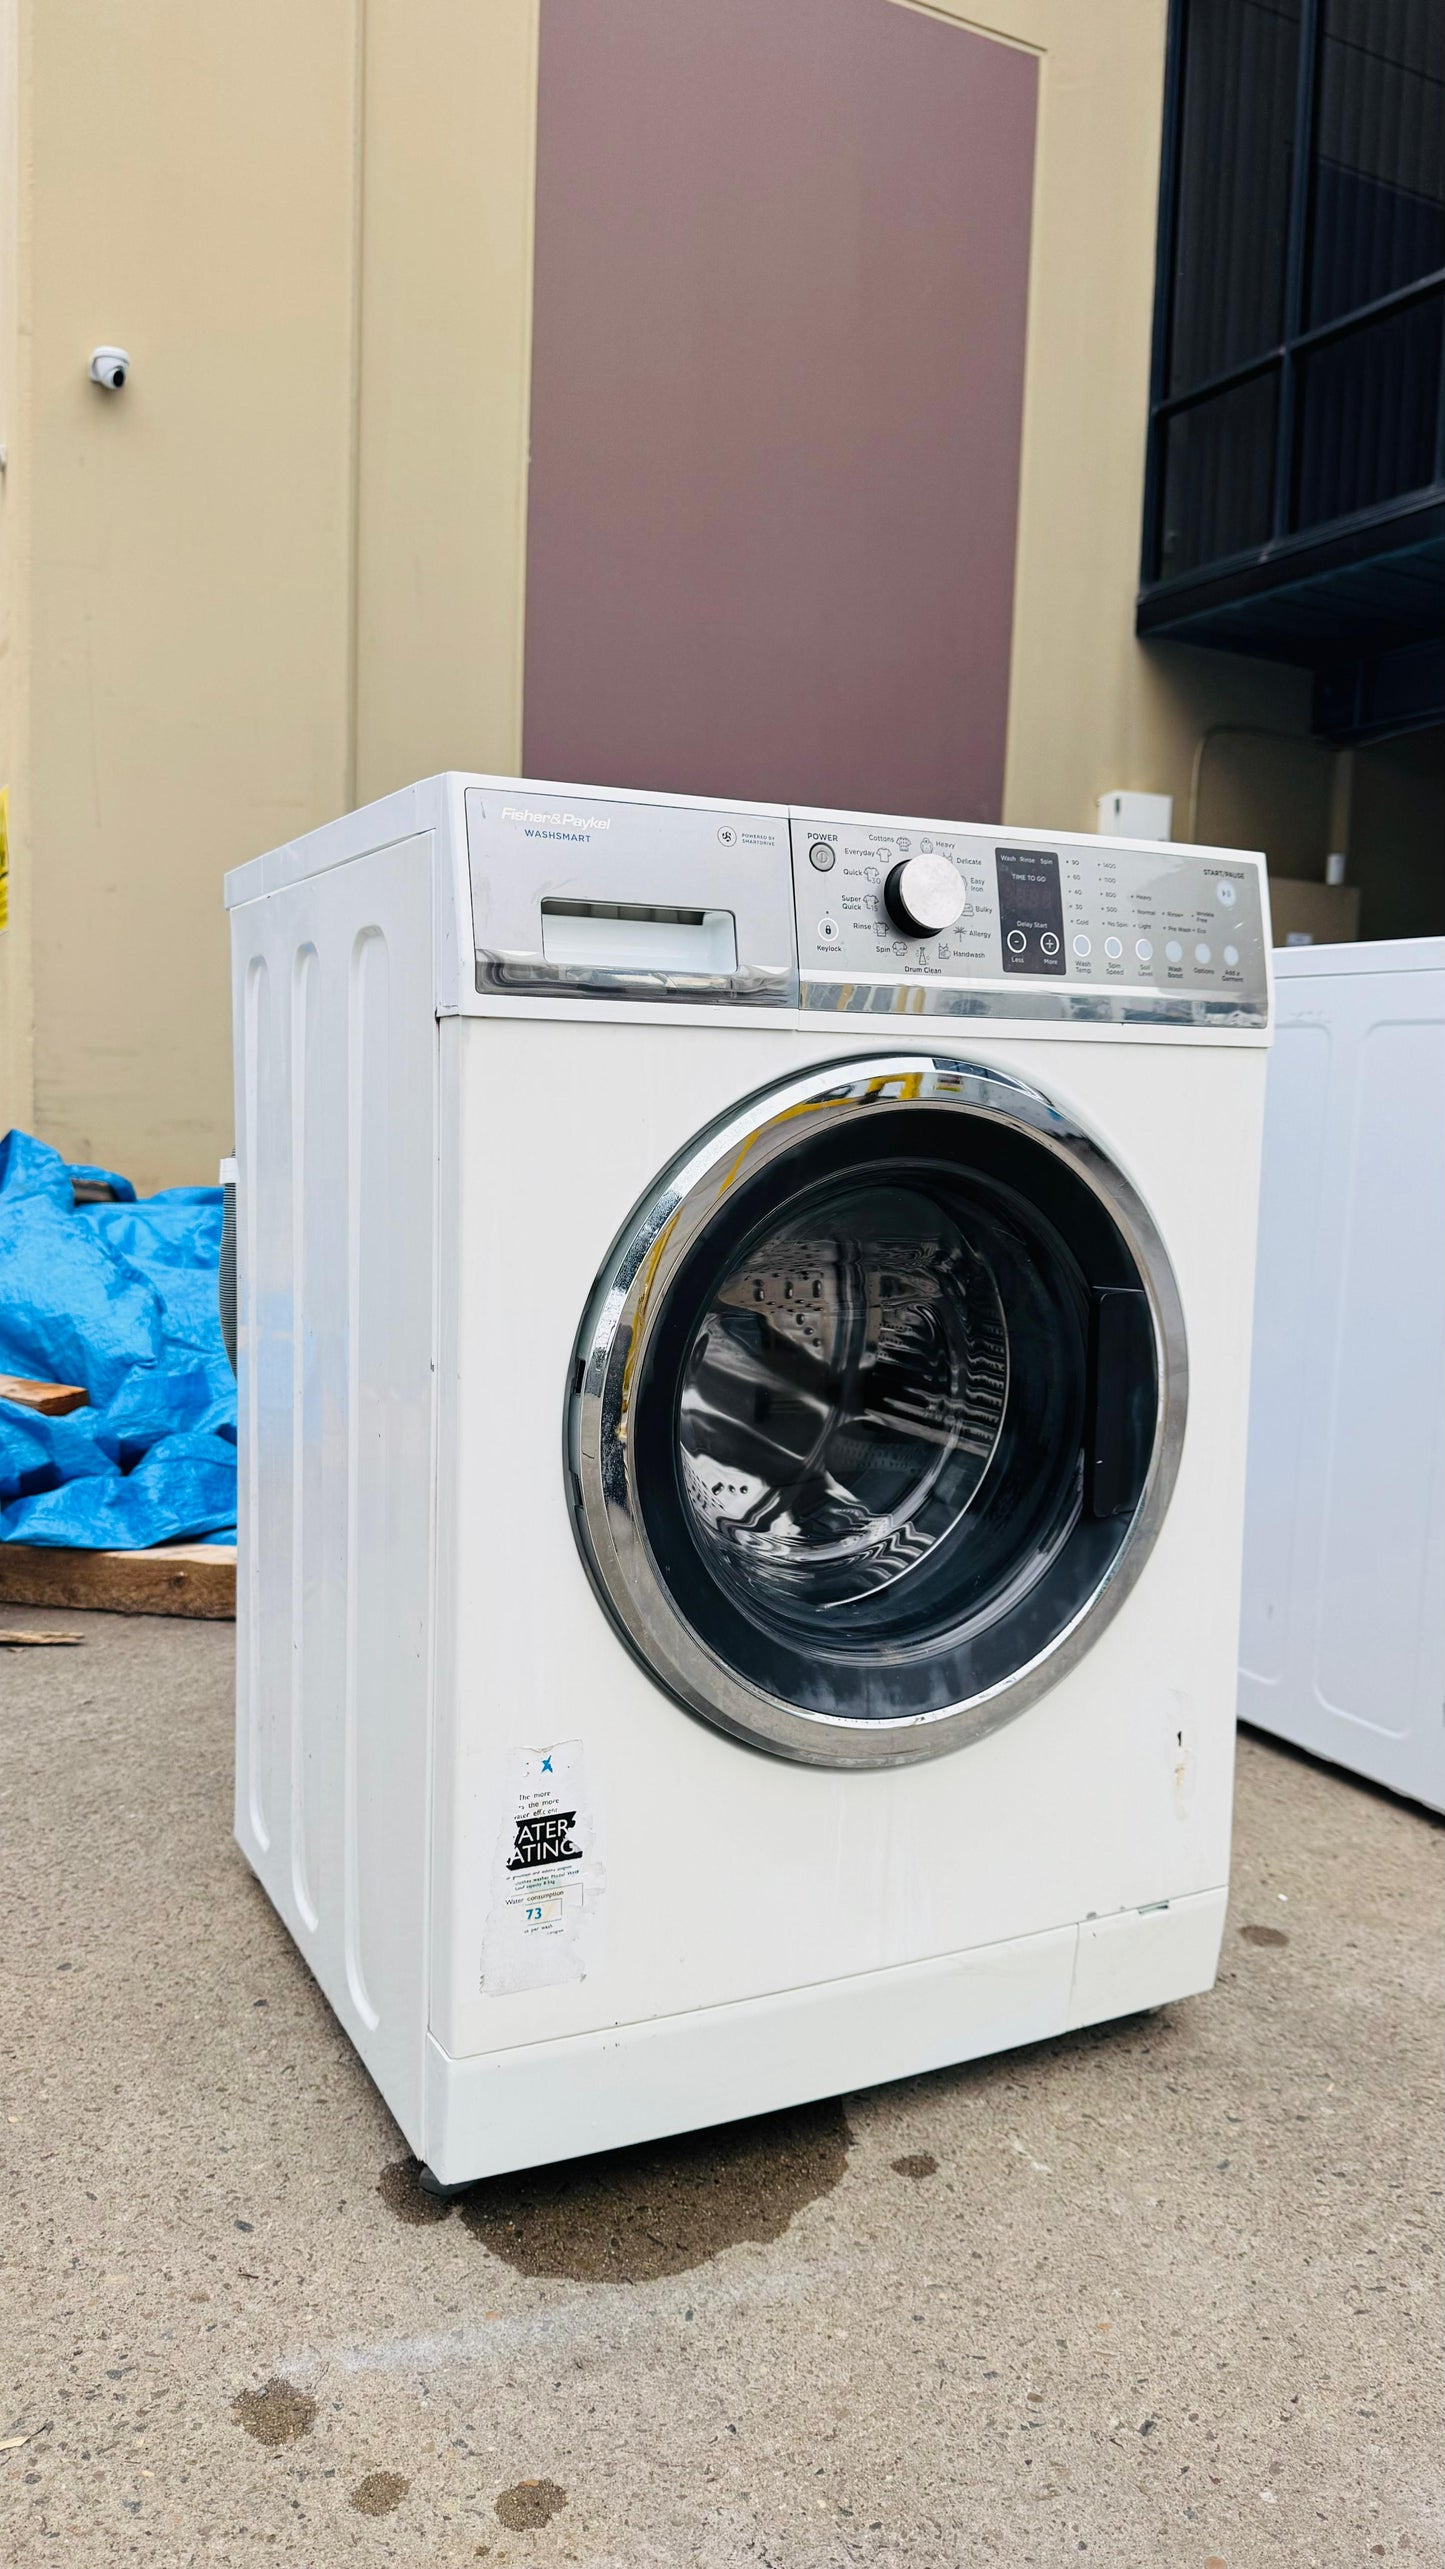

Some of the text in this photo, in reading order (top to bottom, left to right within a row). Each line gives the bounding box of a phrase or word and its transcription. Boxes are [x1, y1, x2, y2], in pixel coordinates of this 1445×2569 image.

[502, 807, 610, 830] Fisher&Paykel
[524, 829, 591, 842] WASHSMART
[808, 833, 838, 841] POWER
[869, 834, 894, 842] Cottons
[936, 841, 955, 849] Heavy
[845, 848, 875, 857] Everyday
[1204, 869, 1244, 879] START/PAUSE
[976, 906, 992, 914] Bulky
[969, 930, 991, 938] Allergy
[518, 1819, 568, 1844] ATER
[507, 1840, 576, 1866] ATING
[527, 1890, 564, 1901] consumption
[526, 1908, 542, 1920] 73
